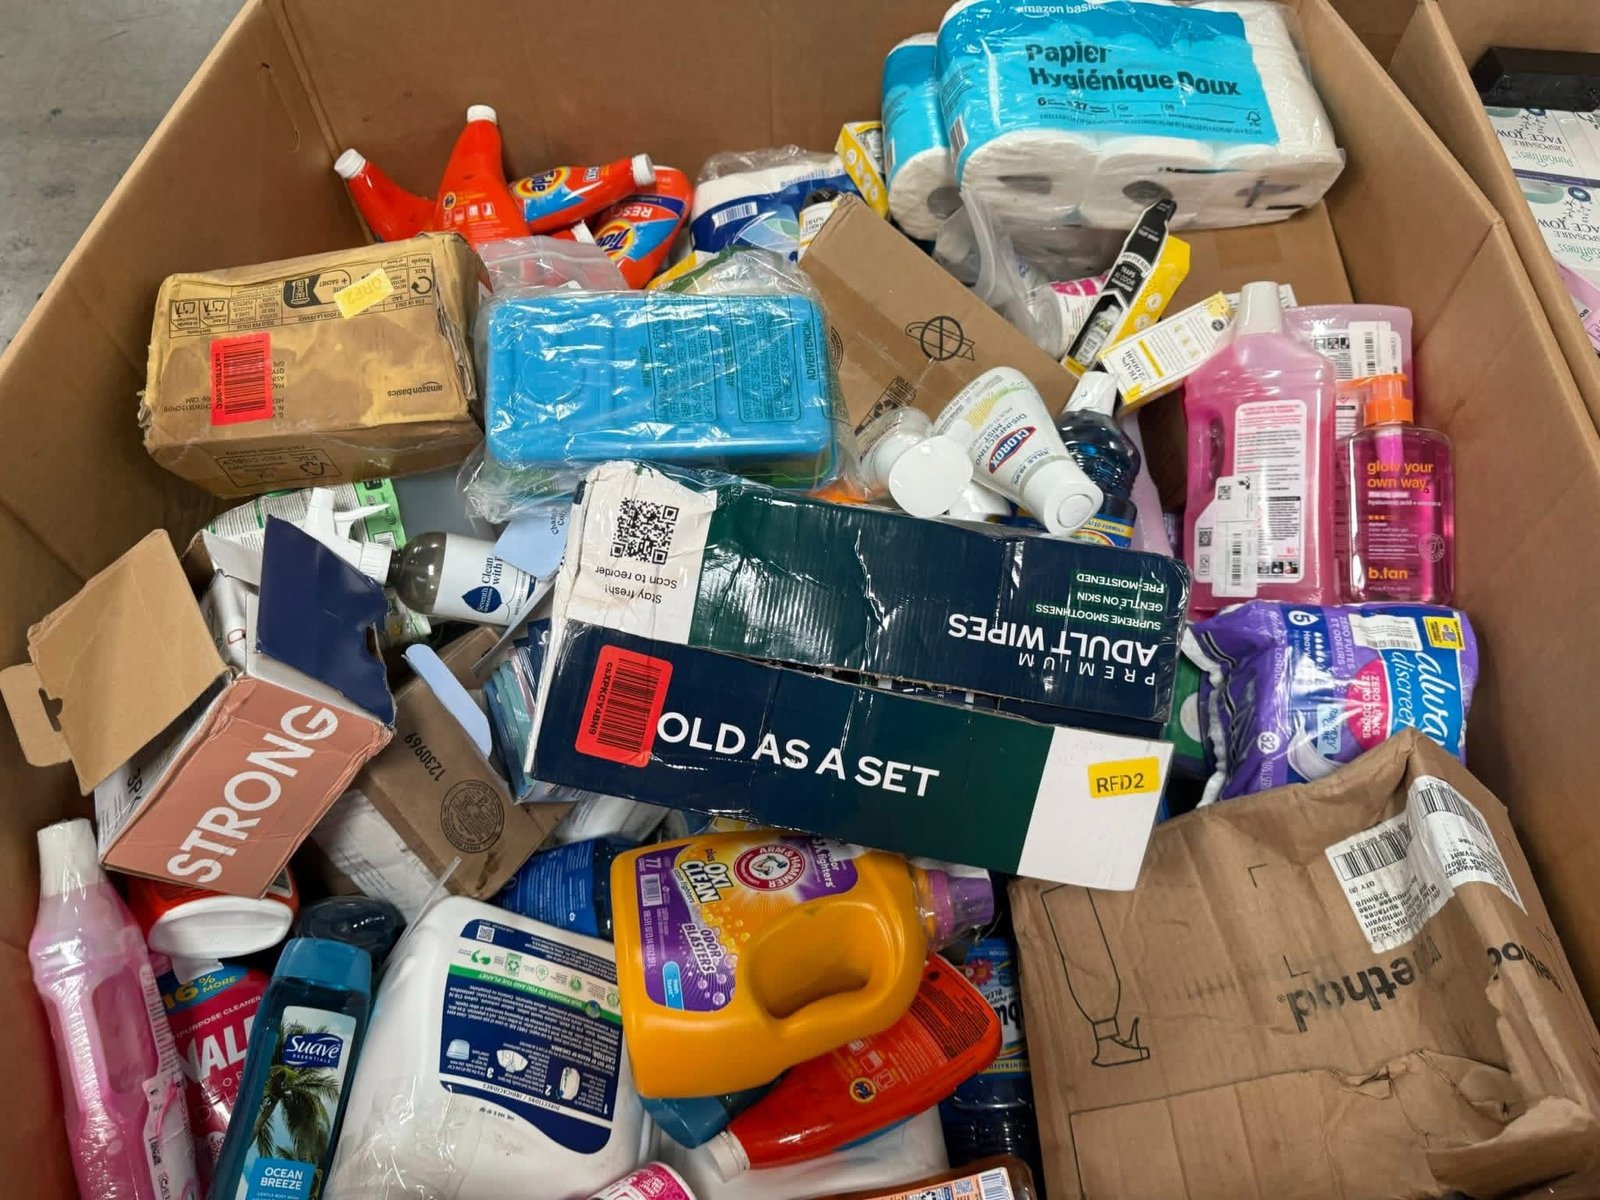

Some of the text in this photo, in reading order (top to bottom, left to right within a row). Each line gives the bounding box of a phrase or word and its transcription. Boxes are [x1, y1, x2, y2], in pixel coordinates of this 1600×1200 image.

[1026, 41, 1111, 67] Papier
[1028, 67, 1242, 96] Hygiénique Doux
[1511, 140, 1566, 152] DISPOSABLE
[1534, 133, 1562, 145] FACE
[1575, 222, 1600, 233] ACE
[387, 383, 444, 398] amazon basics
[972, 411, 1027, 467] DISINFECTING
[981, 420, 1003, 445] MIST
[988, 427, 1030, 471] CLOROX
[1367, 460, 1434, 481] glow your
[1367, 476, 1396, 489] own
[1103, 521, 1125, 533] FORMULA
[481, 556, 495, 585] Clean
[491, 564, 503, 586] with
[594, 567, 678, 589] Scan to reorder
[1368, 567, 1408, 581] b.tan
[1076, 573, 1165, 594] PRE-MOISTENED
[604, 585, 662, 605] Stay fresh!
[1076, 591, 1164, 612] GENTLE ON SKIN
[1034, 603, 1162, 631] SUPREME SMOOTHNESS
[1293, 611, 1311, 623] 5
[947, 613, 1159, 667] ADULT WIPES
[1301, 630, 1313, 661] Heavy
[1332, 629, 1346, 665] ODEURS
[1343, 637, 1356, 669] FUITES
[1017, 652, 1156, 686] PREMIUM
[1368, 674, 1381, 702] ZERO
[1415, 652, 1457, 748] alwa
[1259, 732, 1275, 751] 32
[403, 731, 448, 783] 1230969
[656, 711, 940, 797] OLD AS A SET
[166, 704, 339, 884] STRONG
[758, 846, 784, 855] ARM
[644, 856, 661, 869] 77
[766, 854, 802, 889] HAMMER
[814, 851, 836, 889] fighters
[680, 860, 722, 904] CLEAN
[703, 862, 734, 891] OXI
[1347, 879, 1375, 895] QTY (8)
[1357, 902, 1376, 914] rose
[1359, 901, 1399, 922] surfaces,
[1363, 908, 1403, 928] nettoyant
[682, 923, 715, 973] BLASTERS
[699, 928, 721, 958] ODOR
[477, 971, 503, 984] PLANET
[501, 978, 513, 987] THE
[512, 981, 527, 991] AND
[162, 974, 238, 1010] 16 % MORE
[525, 984, 538, 994] YOU
[222, 994, 262, 1016] CLEANER
[285, 1034, 343, 1059] Suave
[485, 1066, 495, 1079] 3
[543, 1083, 553, 1096] 2
[527, 1095, 561, 1111] DIRECTIONS
[601, 1102, 610, 1114] 1
[259, 1176, 304, 1190] BREEZE
[263, 1166, 304, 1181] OCEAN
